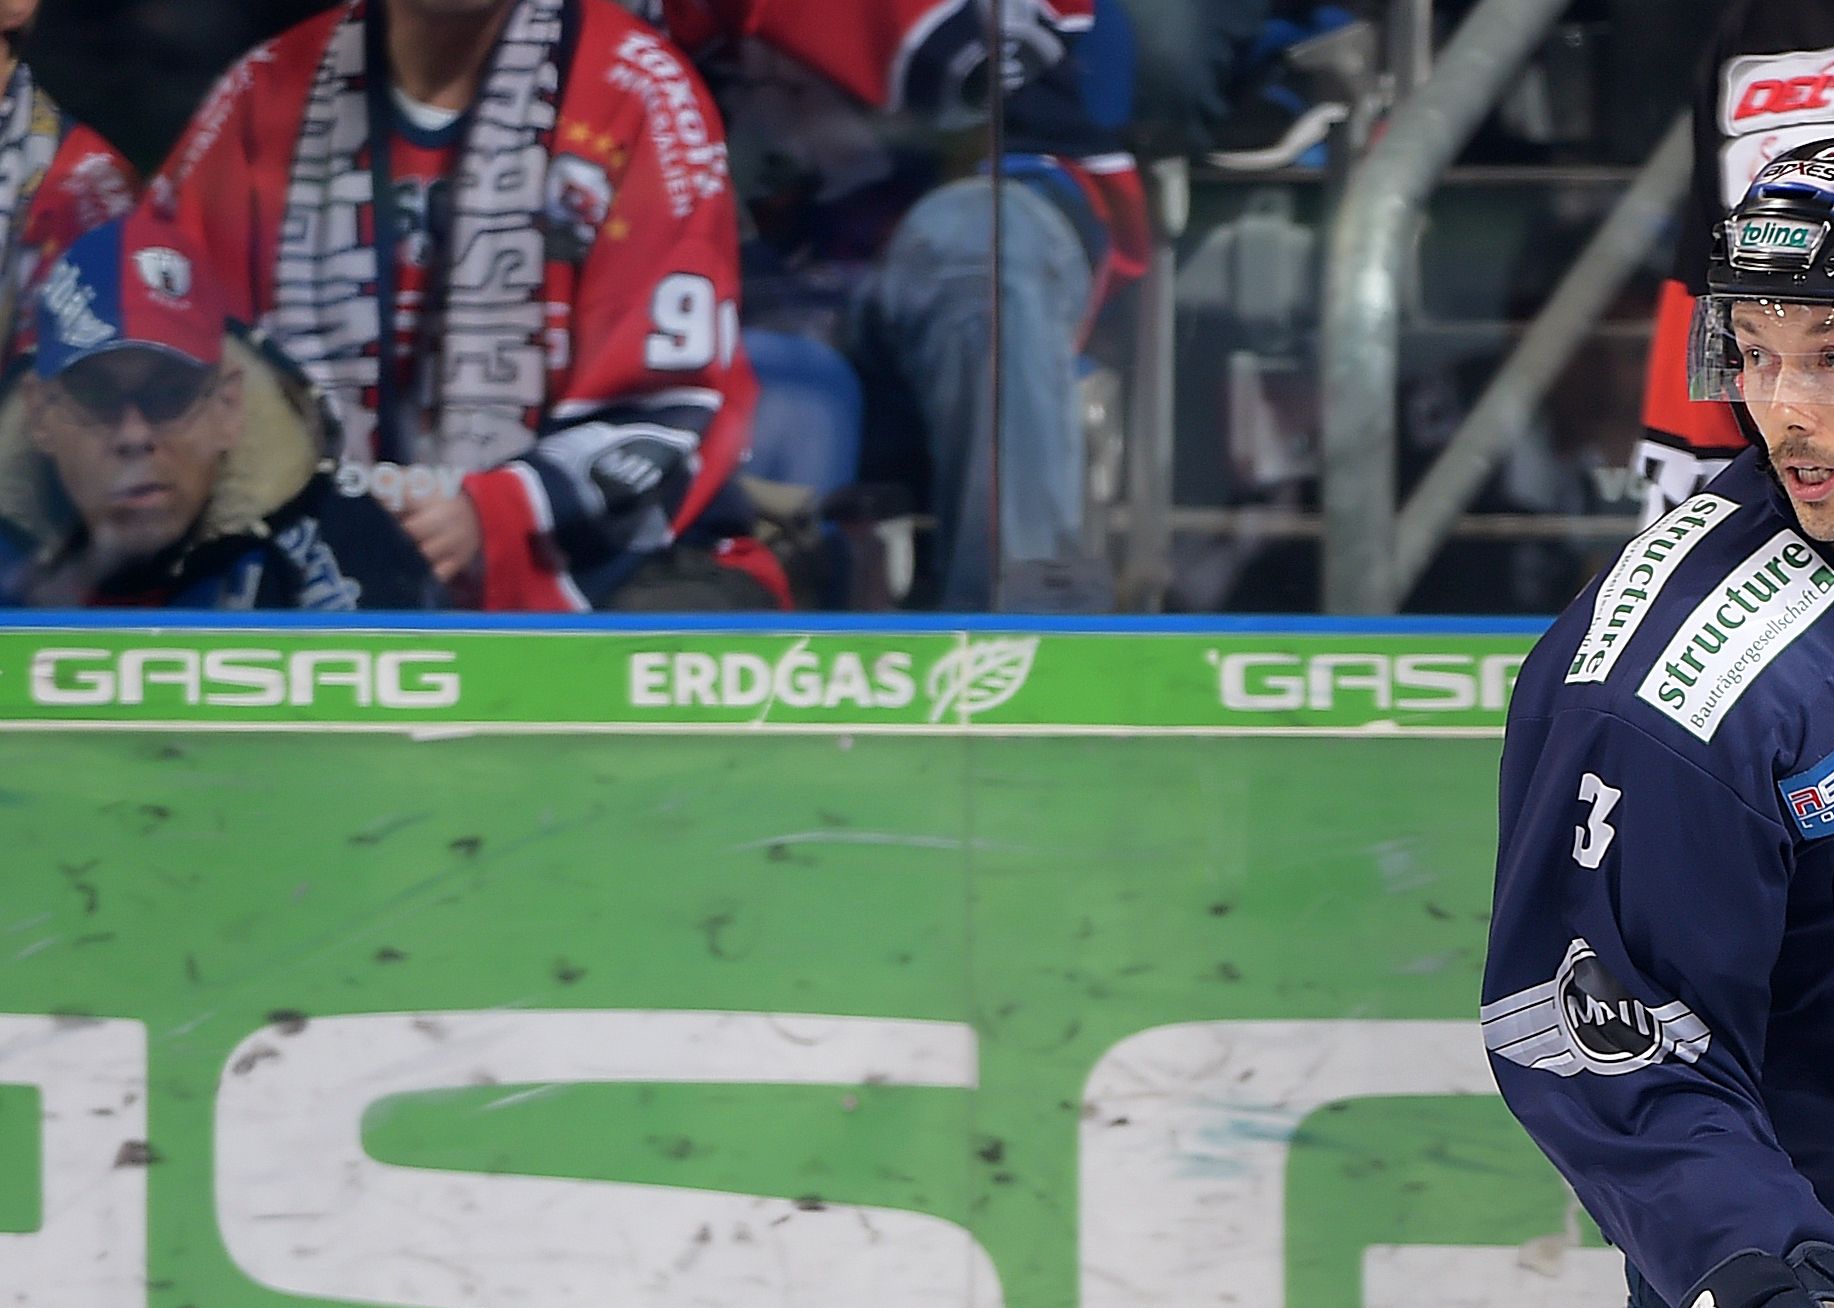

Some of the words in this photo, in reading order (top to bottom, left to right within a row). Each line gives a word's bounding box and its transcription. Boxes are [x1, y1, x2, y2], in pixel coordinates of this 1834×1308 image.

[1740, 221, 1808, 248] tolina
[1585, 498, 1718, 675] structure
[1658, 542, 1814, 711] structure
[30, 648, 461, 708] GASAG
[628, 650, 914, 709] ERDGAS
[1689, 589, 1820, 729] Bauträgergesellschaft
[1571, 772, 1622, 870] 3
